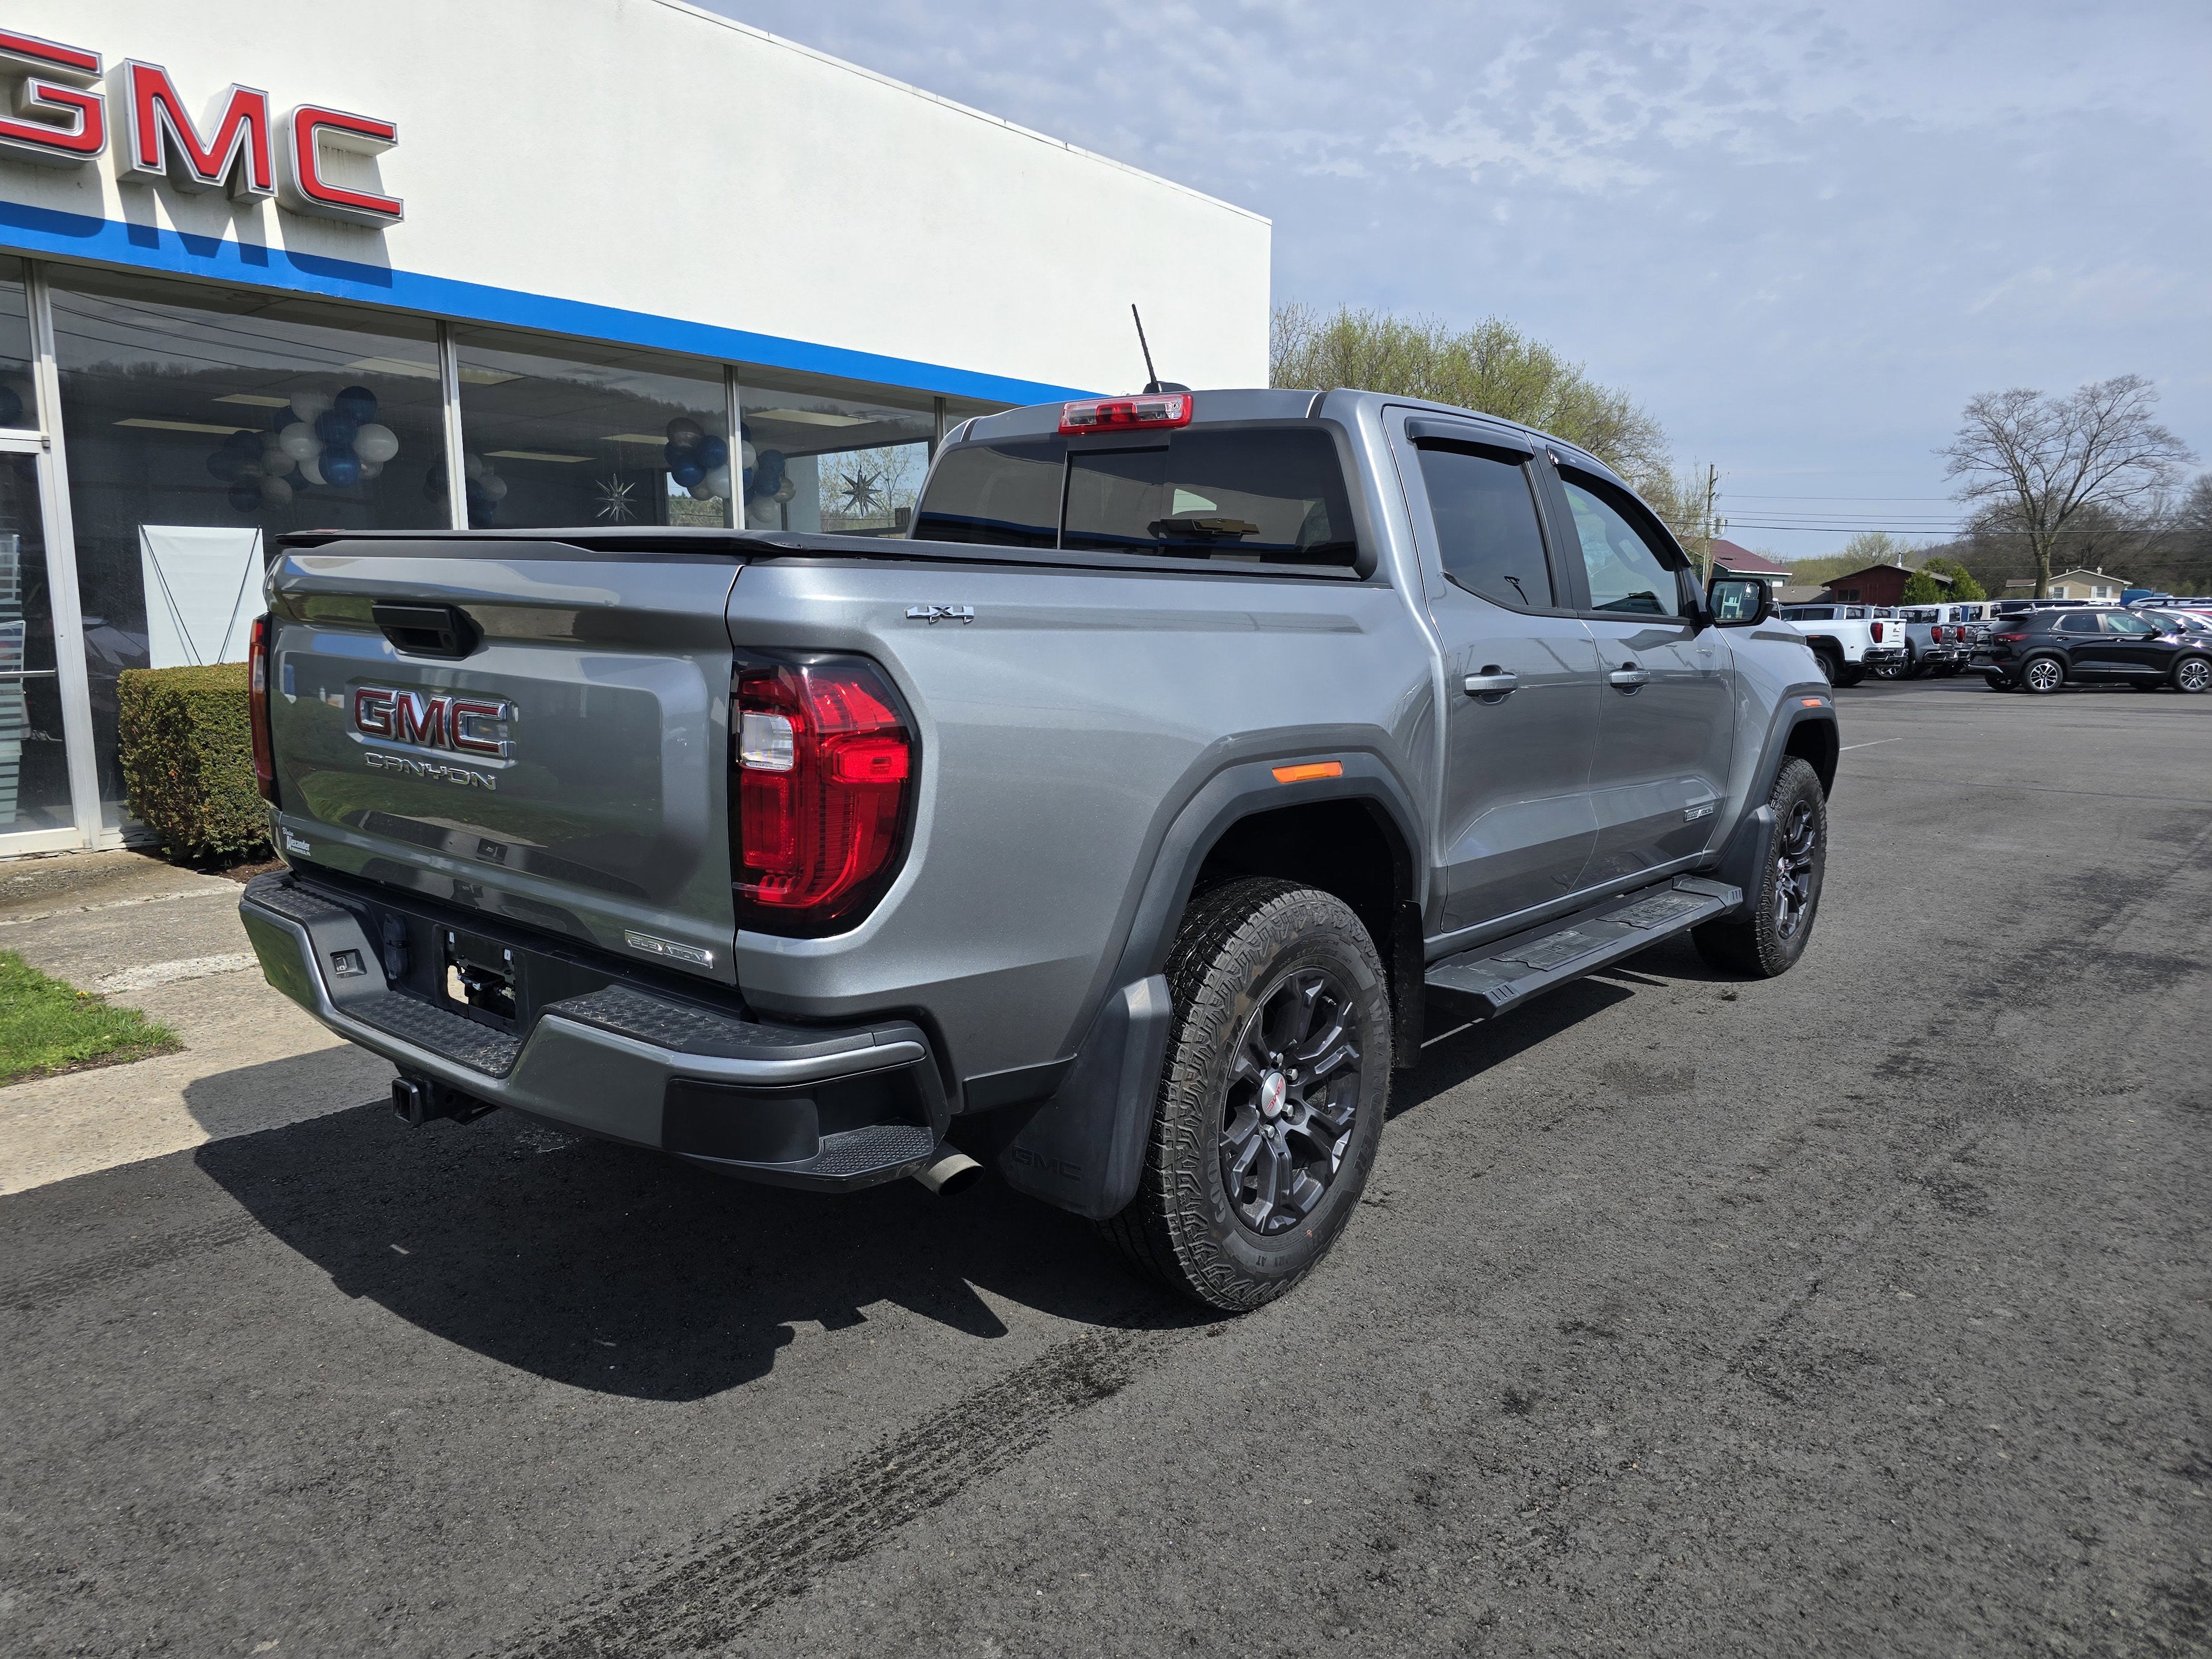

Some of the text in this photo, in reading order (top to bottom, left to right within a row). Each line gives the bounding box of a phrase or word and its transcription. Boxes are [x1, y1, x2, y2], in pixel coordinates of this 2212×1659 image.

[0, 29, 404, 223] GMC
[354, 686, 508, 760] GMC
[364, 752, 497, 790] CANYON
[1353, 997, 1384, 1176] WRANGLER
[1011, 1145, 1082, 1182] GMC
